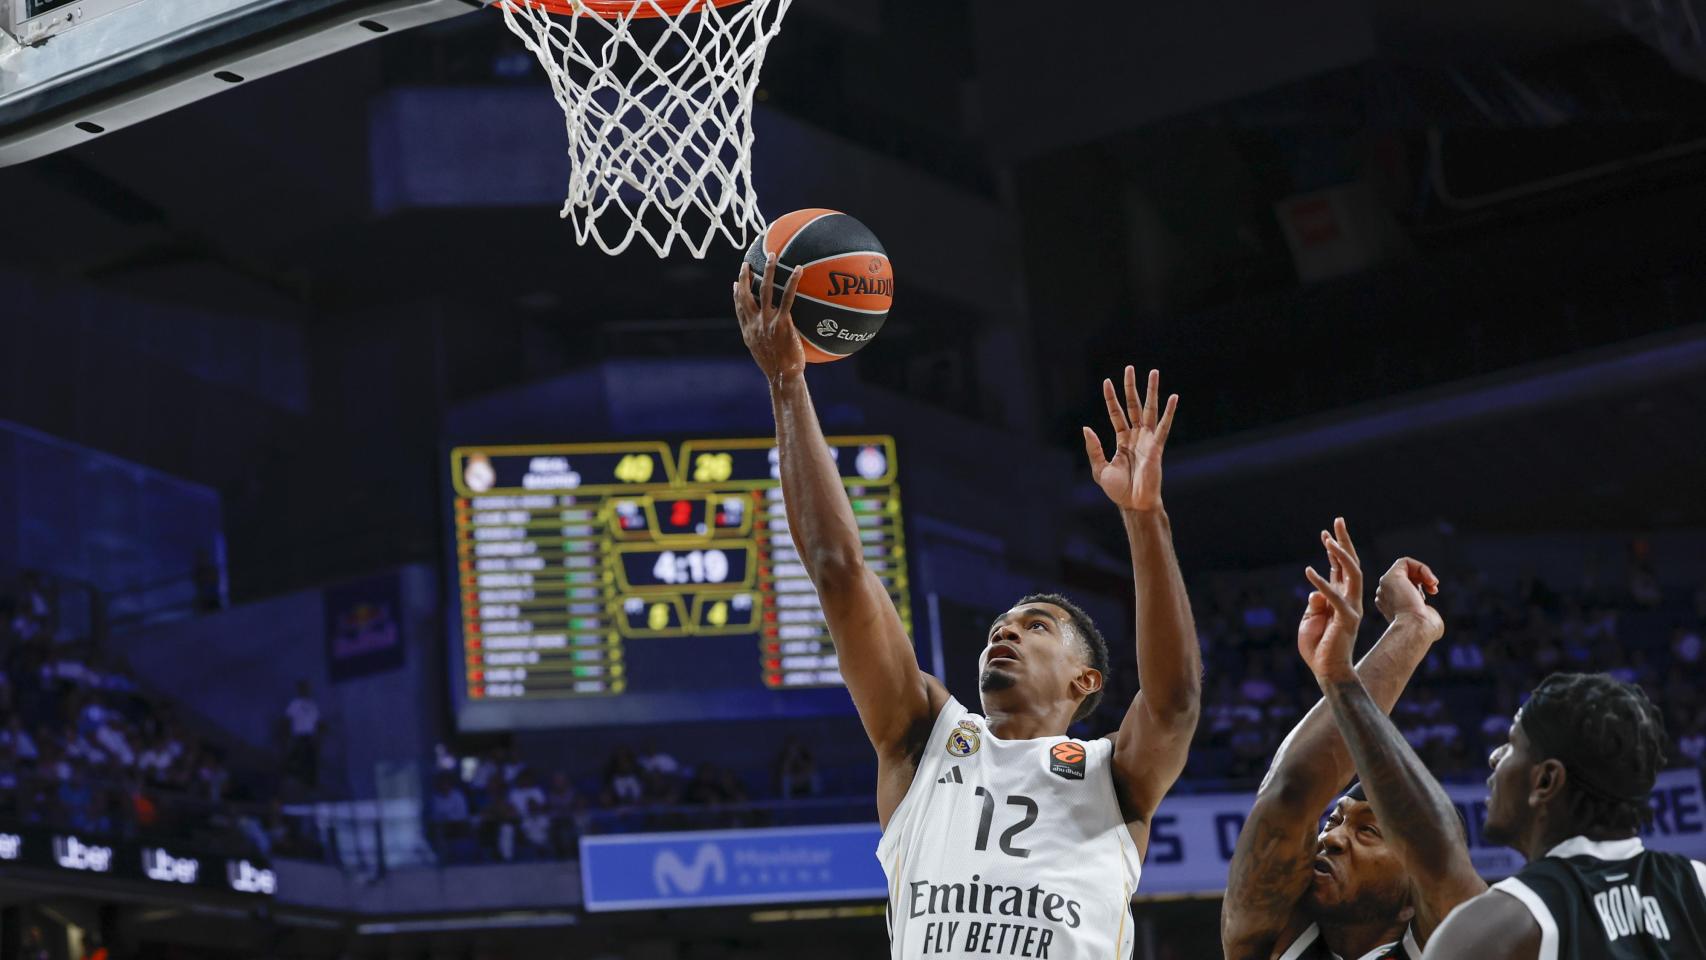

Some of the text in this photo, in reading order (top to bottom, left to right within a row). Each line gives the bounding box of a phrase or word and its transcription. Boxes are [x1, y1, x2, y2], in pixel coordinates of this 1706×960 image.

[653, 550, 729, 584] 4:19
[707, 602, 727, 627] 4
[974, 786, 1039, 859] 12
[1645, 786, 1704, 836] RE
[53, 835, 113, 872] Uber
[1149, 815, 1184, 864] S
[141, 847, 199, 884] Uber
[226, 859, 278, 895] Ube
[909, 873, 1081, 928] Emirates
[1592, 883, 1671, 943] BONA
[922, 921, 1054, 960] FLY BETTER
